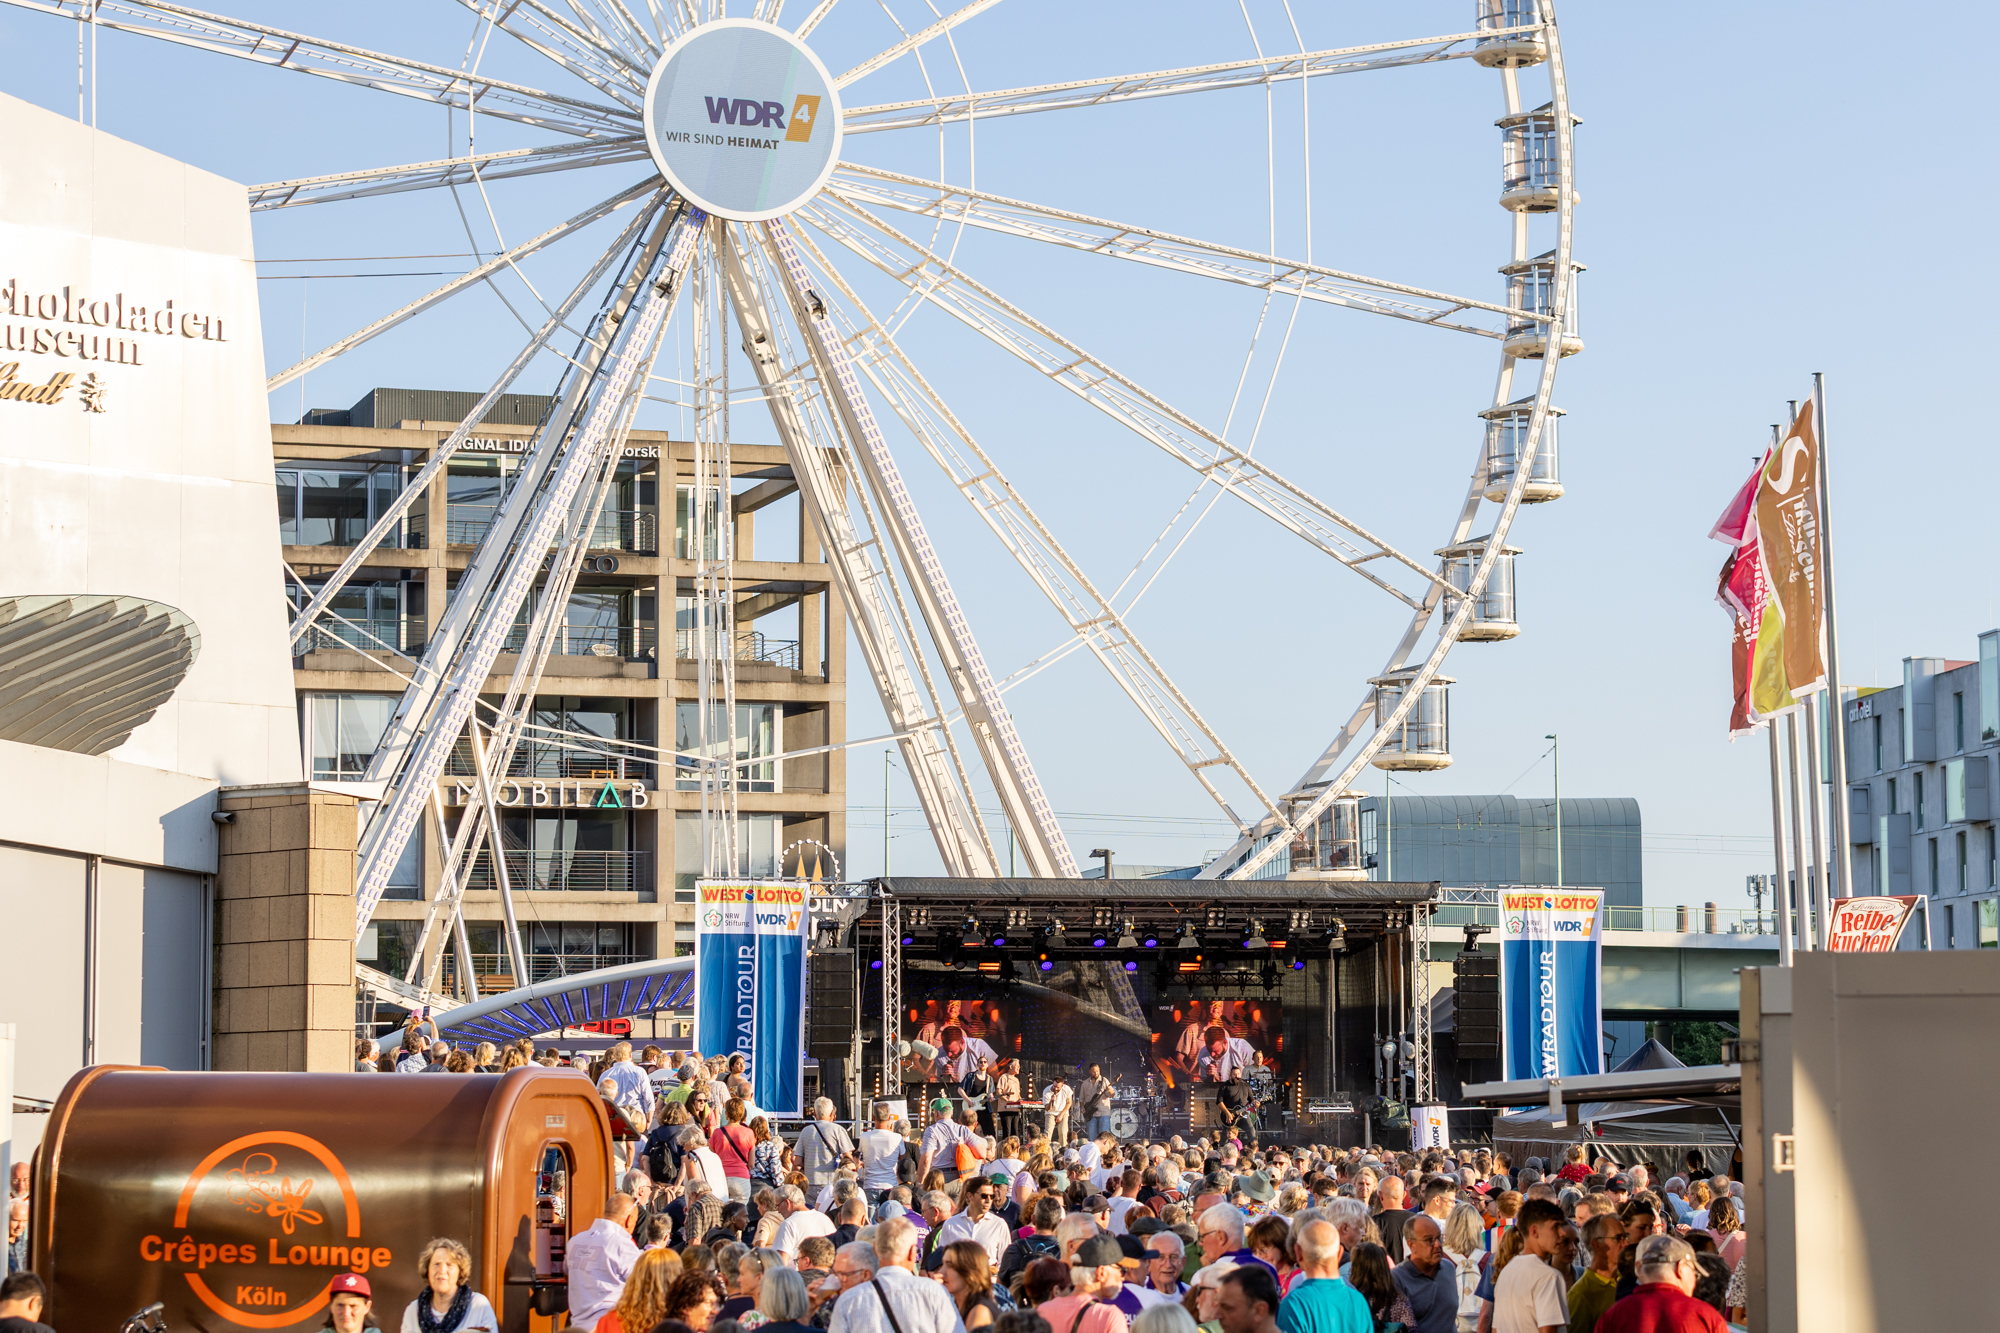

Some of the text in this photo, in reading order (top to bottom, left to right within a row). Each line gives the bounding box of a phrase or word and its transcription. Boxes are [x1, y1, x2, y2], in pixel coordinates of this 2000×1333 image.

[704, 96, 786, 129] WDR
[666, 131, 779, 150] WIR SIND HEIMAT
[0, 324, 144, 366] useum
[456, 779, 649, 808] MOBILAB
[703, 889, 803, 903] WEST LOTTO
[1506, 897, 1597, 909] WEST LOTTO
[725, 919, 750, 928] Stiftung
[756, 913, 786, 925] WDR
[1554, 920, 1582, 932] WDR
[1841, 910, 1897, 933] Reibe-
[1831, 932, 1891, 952] kuchen
[1432, 1126, 1440, 1147] WDR
[140, 1235, 392, 1273] Crêpes Lounge
[236, 1286, 287, 1306] Köln
